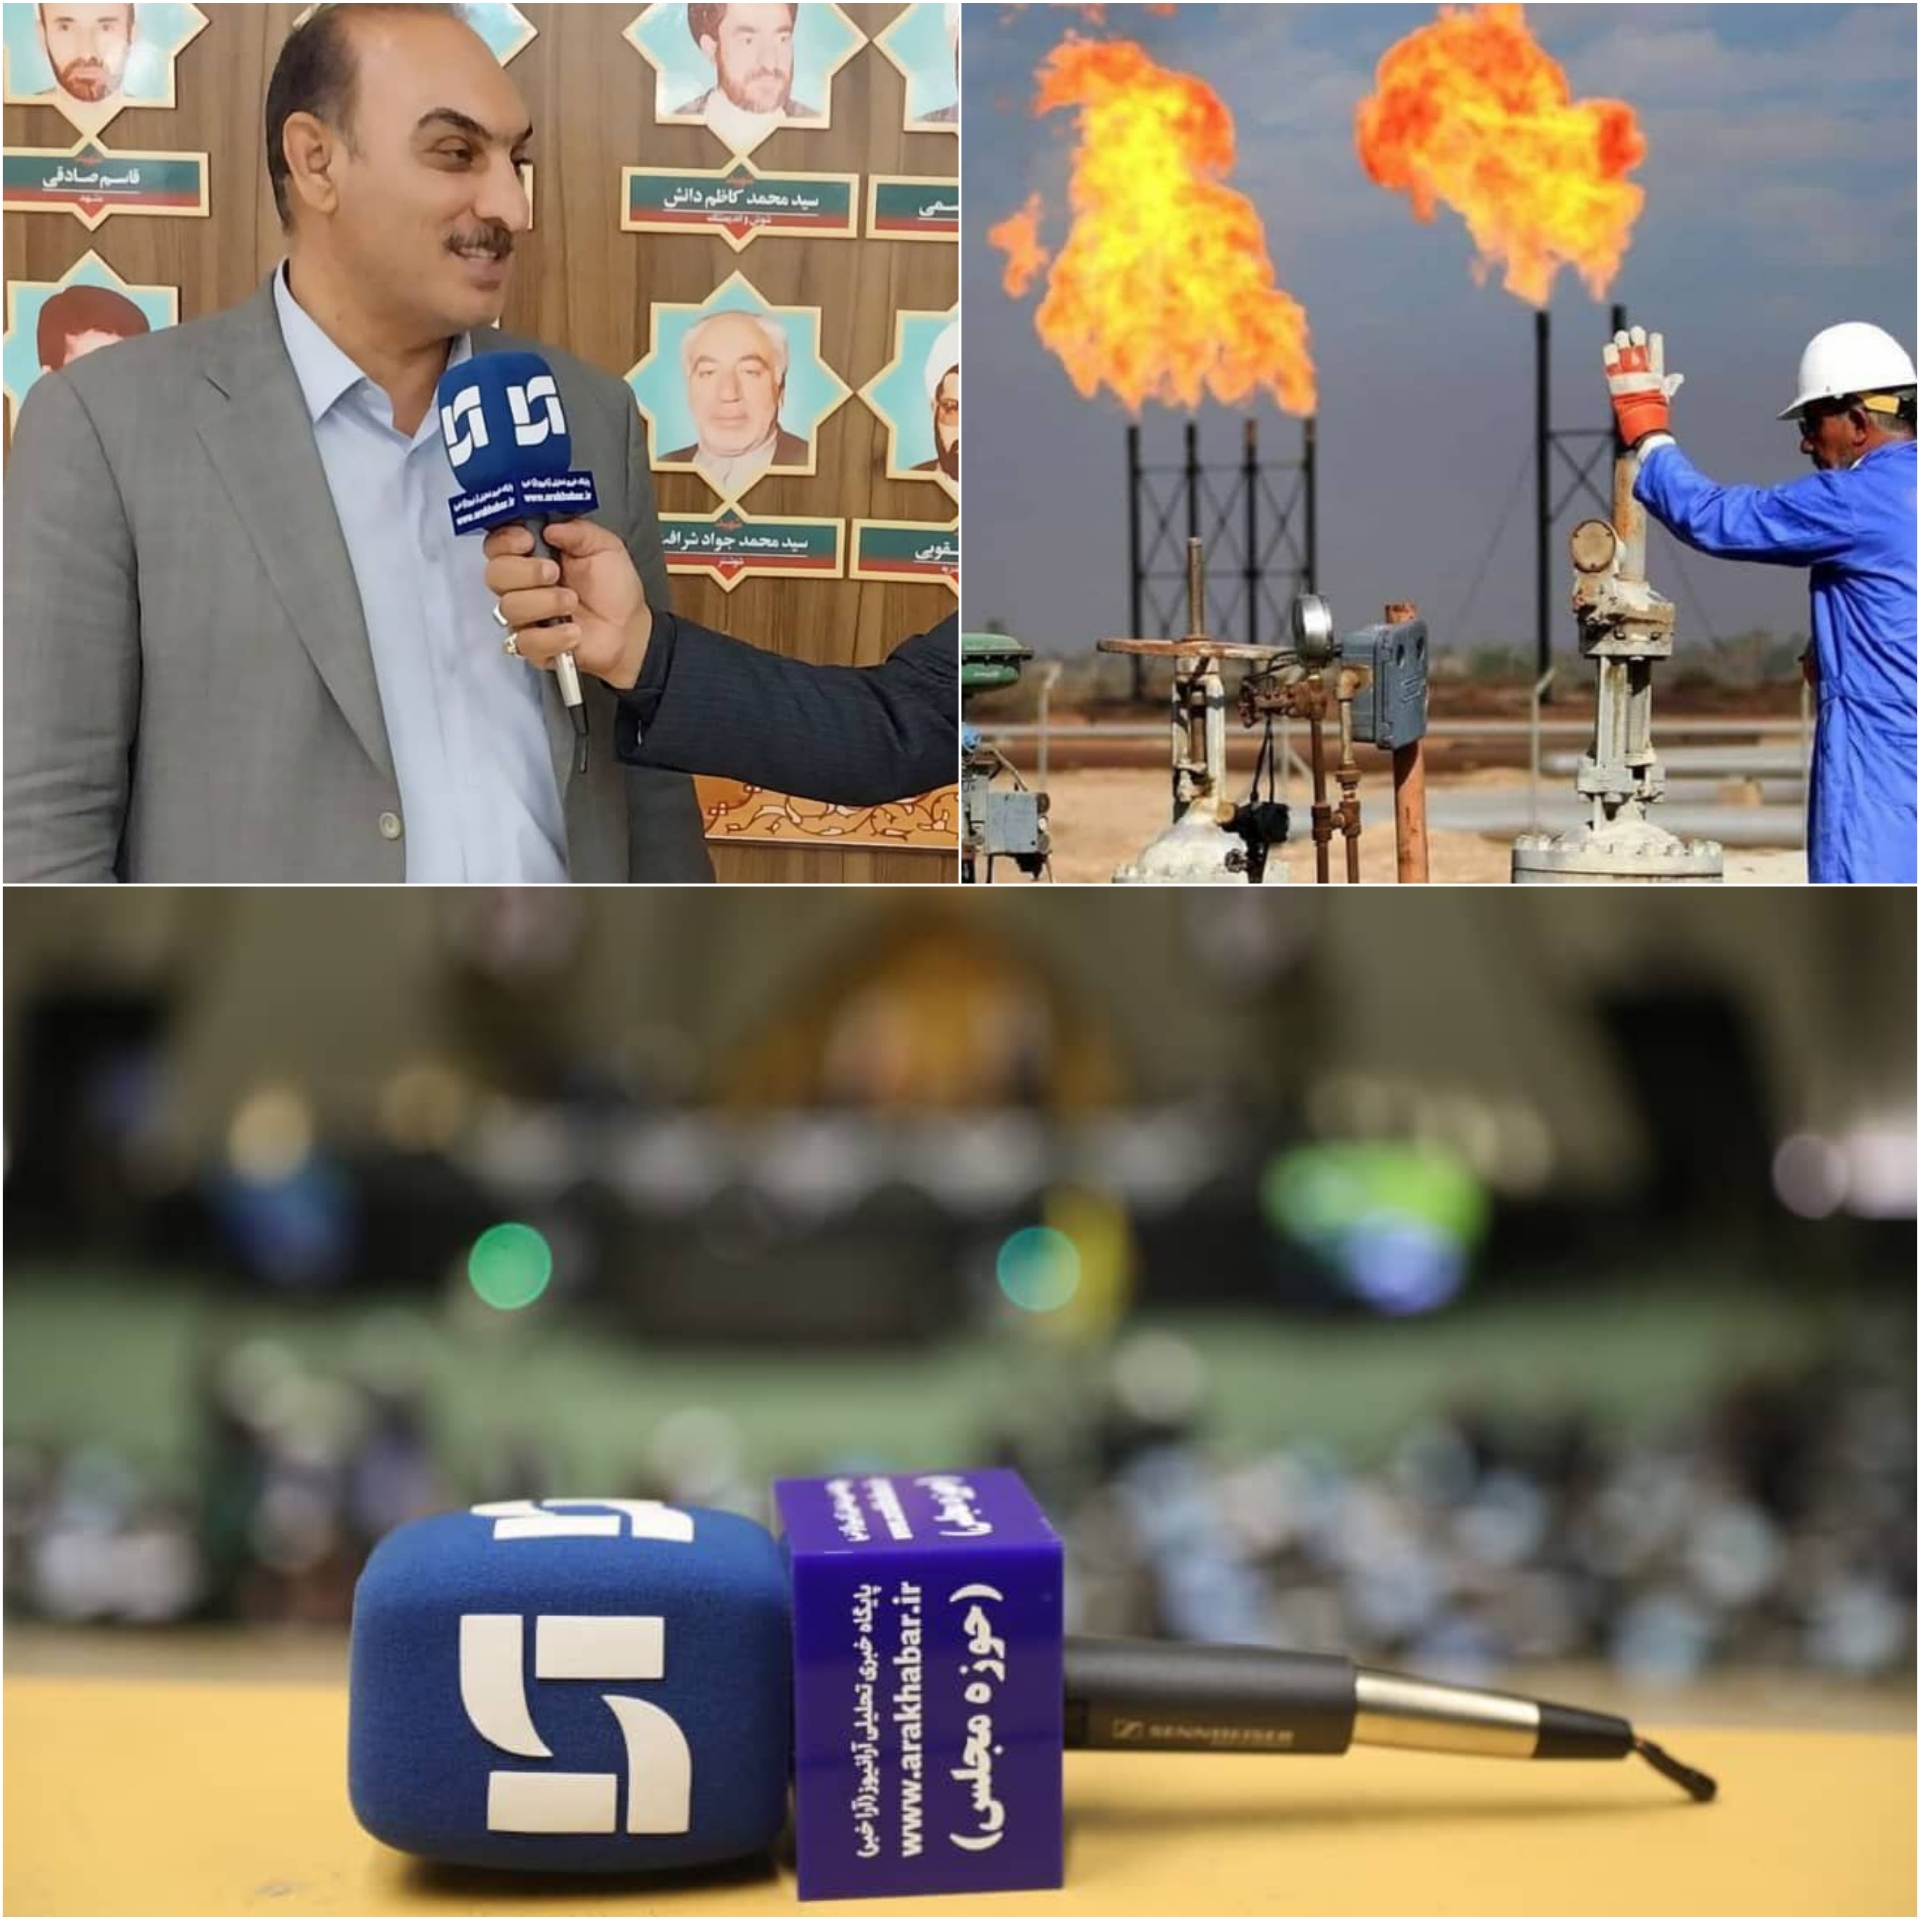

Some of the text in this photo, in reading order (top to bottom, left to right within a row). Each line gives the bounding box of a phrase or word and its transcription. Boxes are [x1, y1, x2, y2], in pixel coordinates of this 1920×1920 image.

[42, 166, 141, 188] قاسم صادقی
[663, 186, 820, 212] سید محمد کاظم دانش
[700, 531, 736, 552] جواد
[738, 534, 780, 549] محمد
[781, 537, 809, 553] سید
[852, 1583, 882, 1633] پایگاه
[853, 1635, 879, 1681] خبری
[853, 1683, 880, 1741] تحلیلی
[892, 1581, 923, 1858] www.arakhabar.ir
